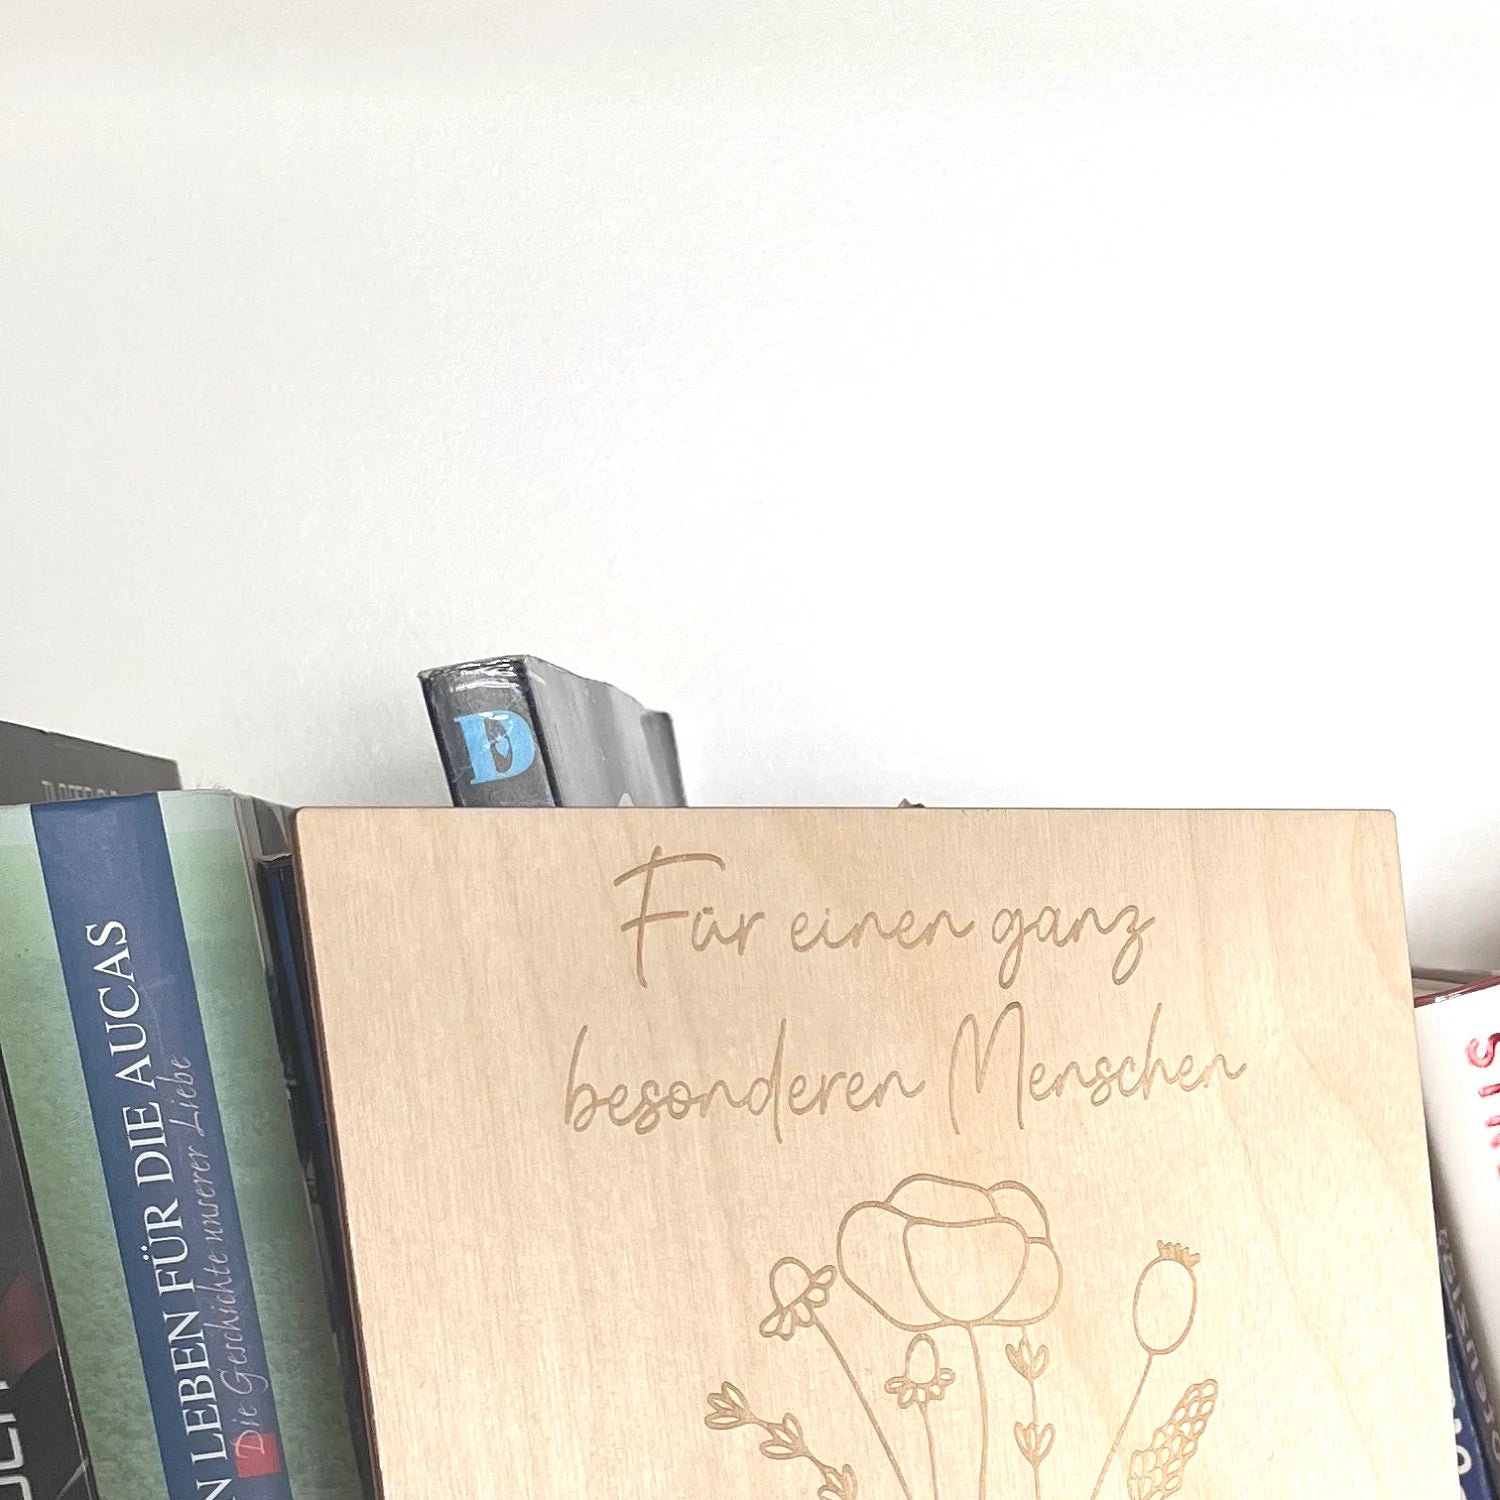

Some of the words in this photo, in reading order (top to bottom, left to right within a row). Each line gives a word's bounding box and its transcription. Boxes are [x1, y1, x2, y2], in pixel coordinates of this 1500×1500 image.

[790, 905, 974, 954] einen
[990, 903, 1156, 990] ganz
[85, 920, 157, 1090] AUCAS
[155, 1055, 206, 1138] Liebe
[564, 1018, 926, 1144] besonderen
[950, 1001, 1248, 1136] Menschen
[121, 1101, 175, 1187] DIE
[141, 1198, 197, 1297] FÜR
[190, 1145, 225, 1250] unserer
[196, 1250, 269, 1395] Geschichte
[163, 1310, 229, 1464] LEBEN
[231, 1405, 267, 1460] Die
